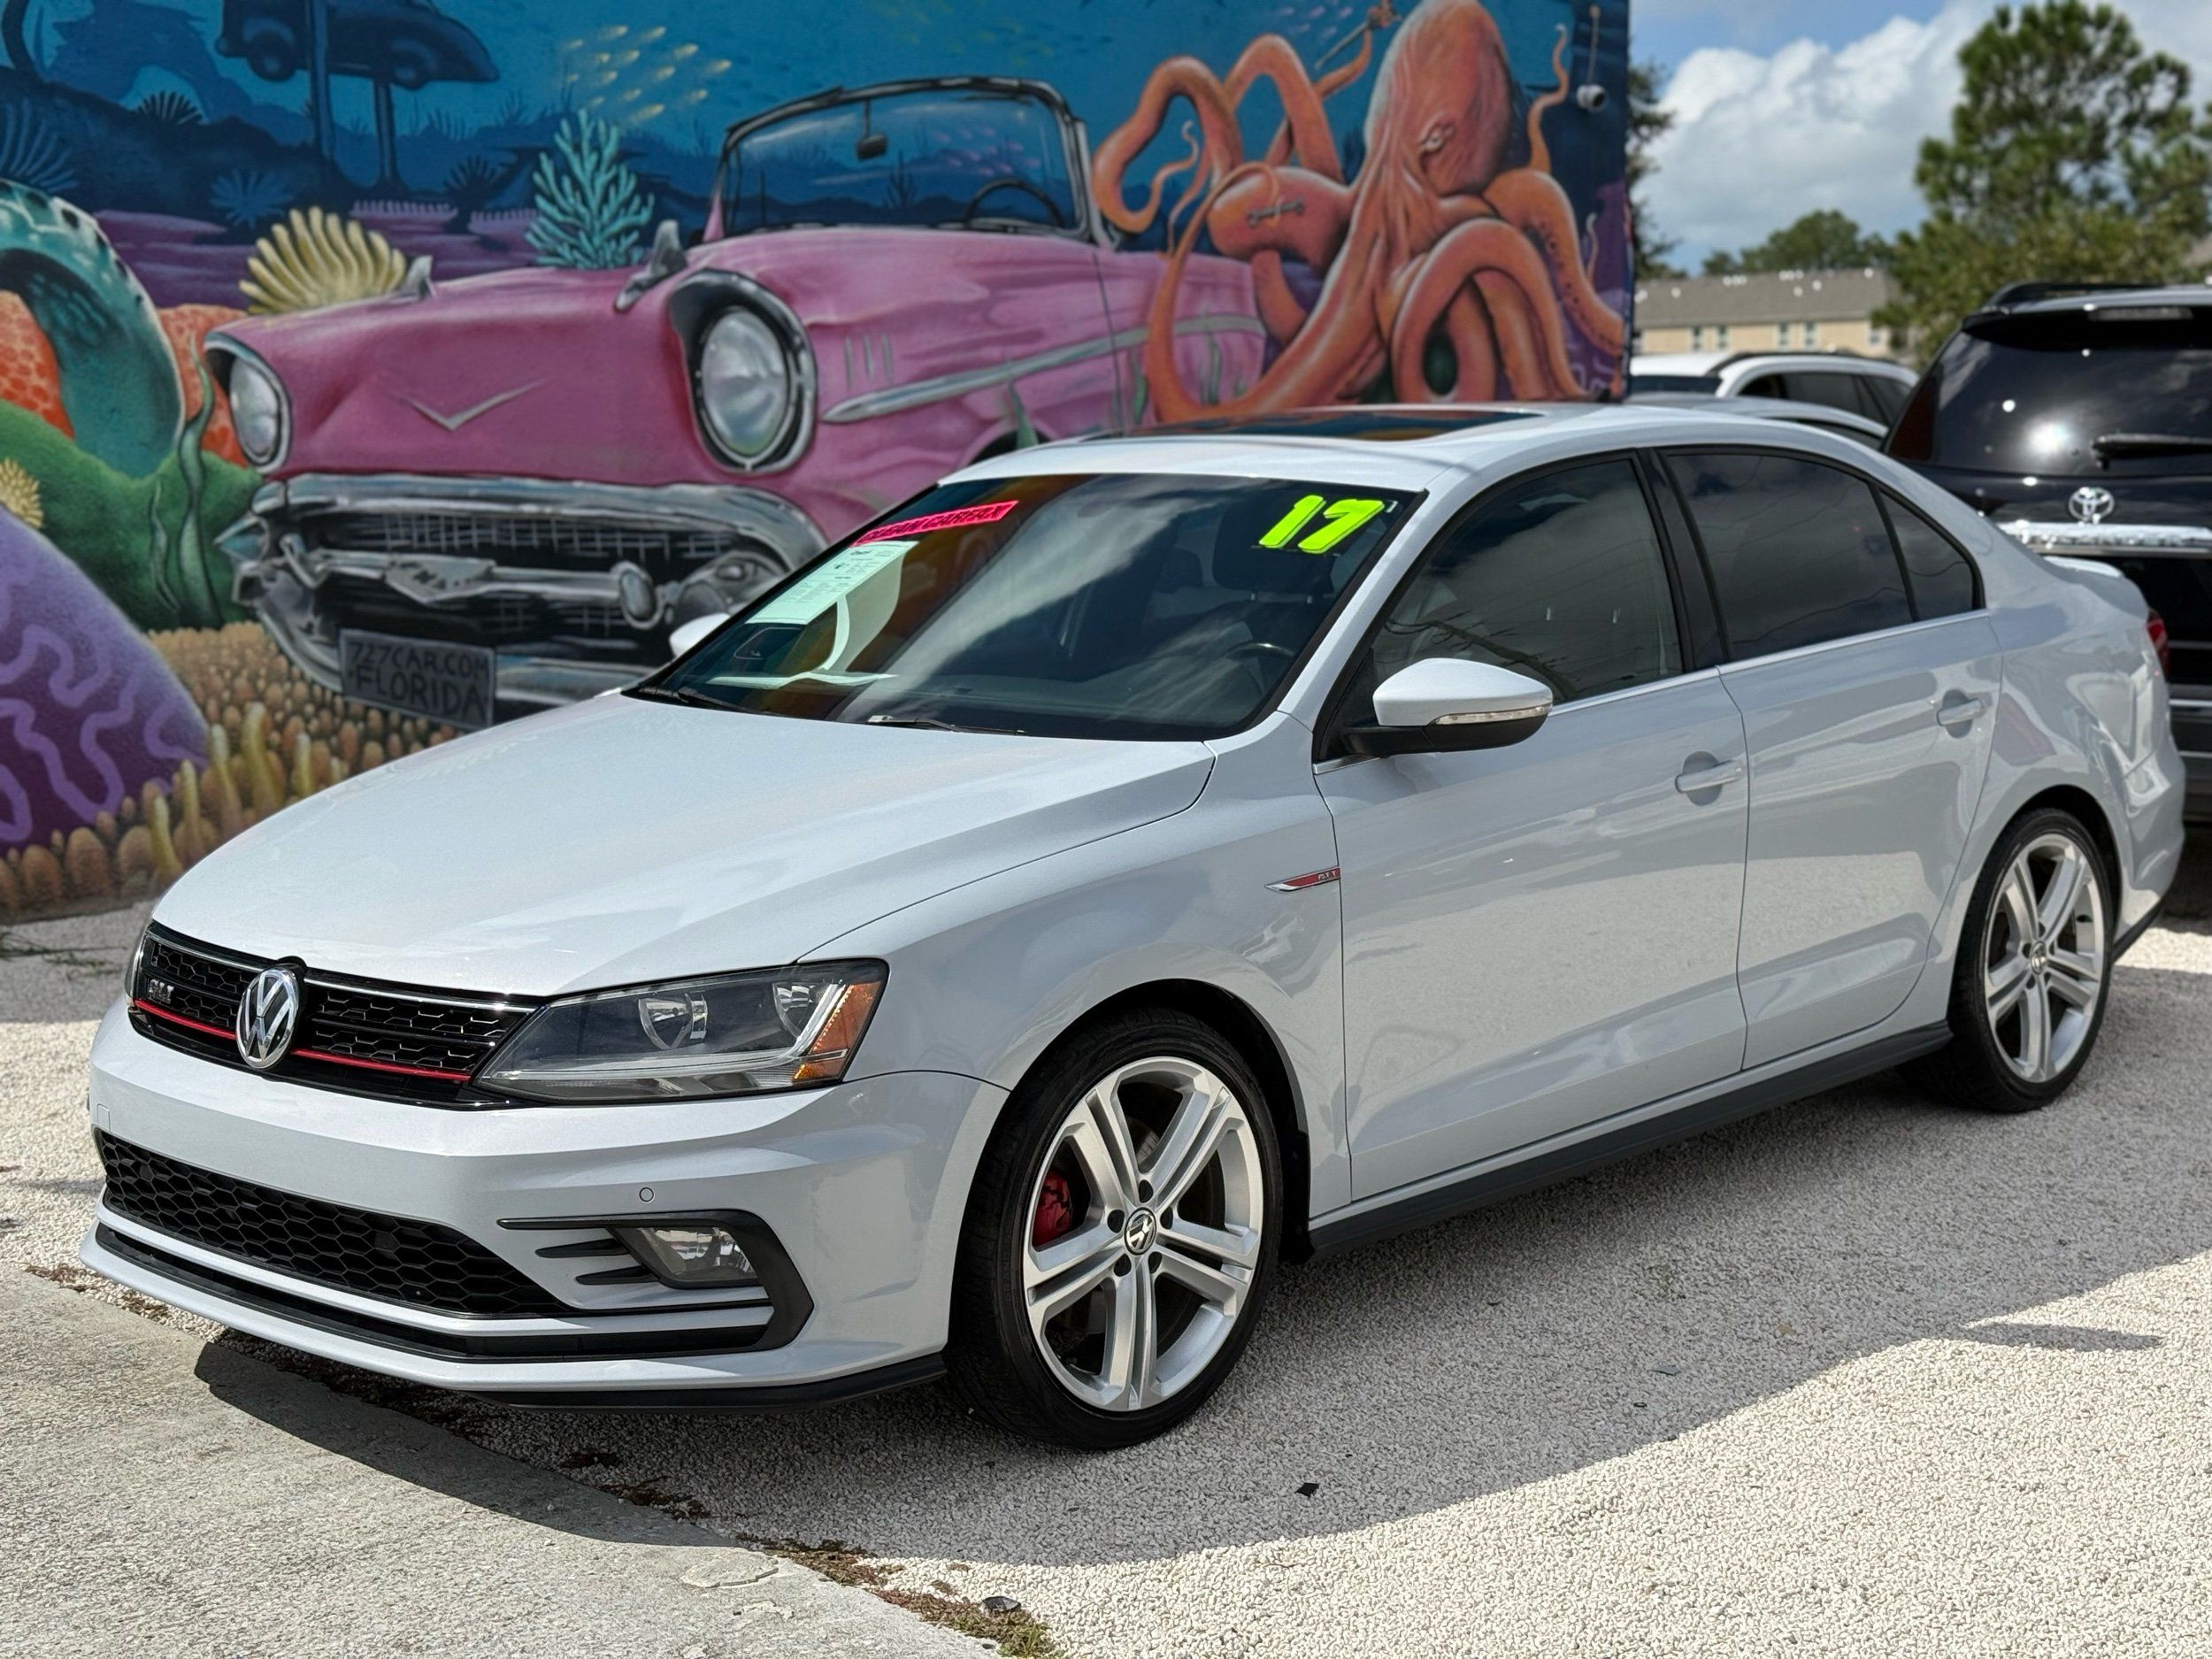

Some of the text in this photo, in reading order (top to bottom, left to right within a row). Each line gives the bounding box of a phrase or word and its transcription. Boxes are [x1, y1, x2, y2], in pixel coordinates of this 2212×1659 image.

[922, 504, 1014, 528] CARFAX
[1259, 495, 1385, 554] 17
[356, 665, 487, 720] FLORIDA
